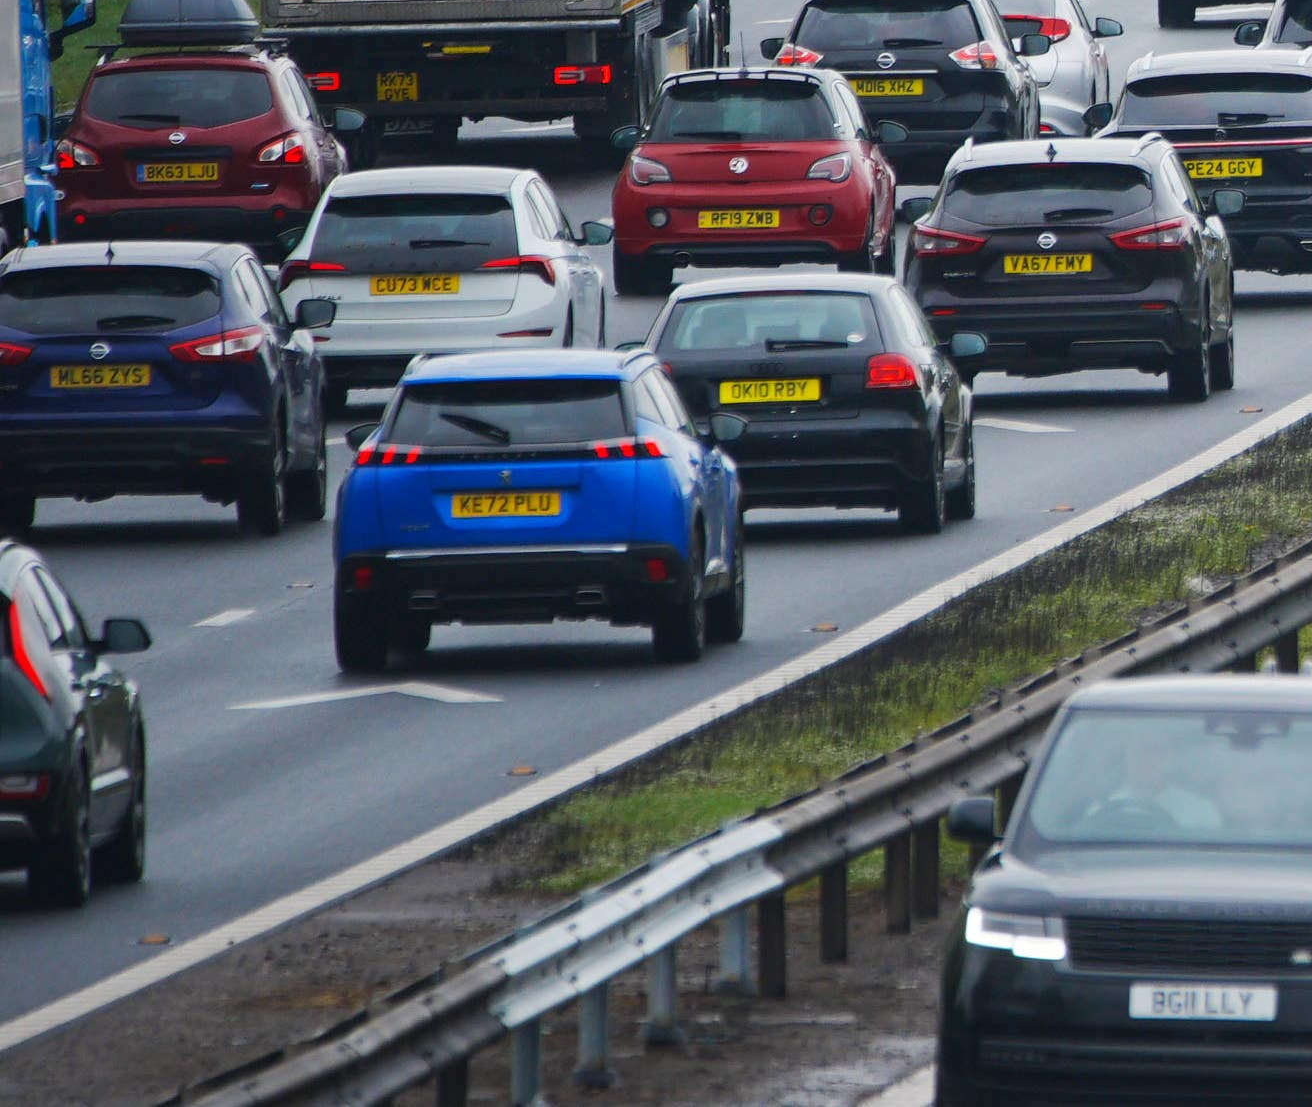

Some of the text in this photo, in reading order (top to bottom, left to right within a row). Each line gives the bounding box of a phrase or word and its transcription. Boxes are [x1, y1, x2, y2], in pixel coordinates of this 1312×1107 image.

[380, 74, 414, 86] RK73
[856, 80, 915, 93] MD16 XHZ
[146, 164, 216, 179] BK63 LJU
[1187, 161, 1255, 176] PE24 GGY
[711, 212, 774, 225] RF19 ZWB
[1010, 256, 1085, 271] VA67 FMY
[376, 278, 418, 293] CU73
[108, 365, 143, 384] ZYS
[774, 382, 808, 398] RBY
[459, 495, 551, 513] KE72 PLU
[1205, 992, 1254, 1015] LLY
